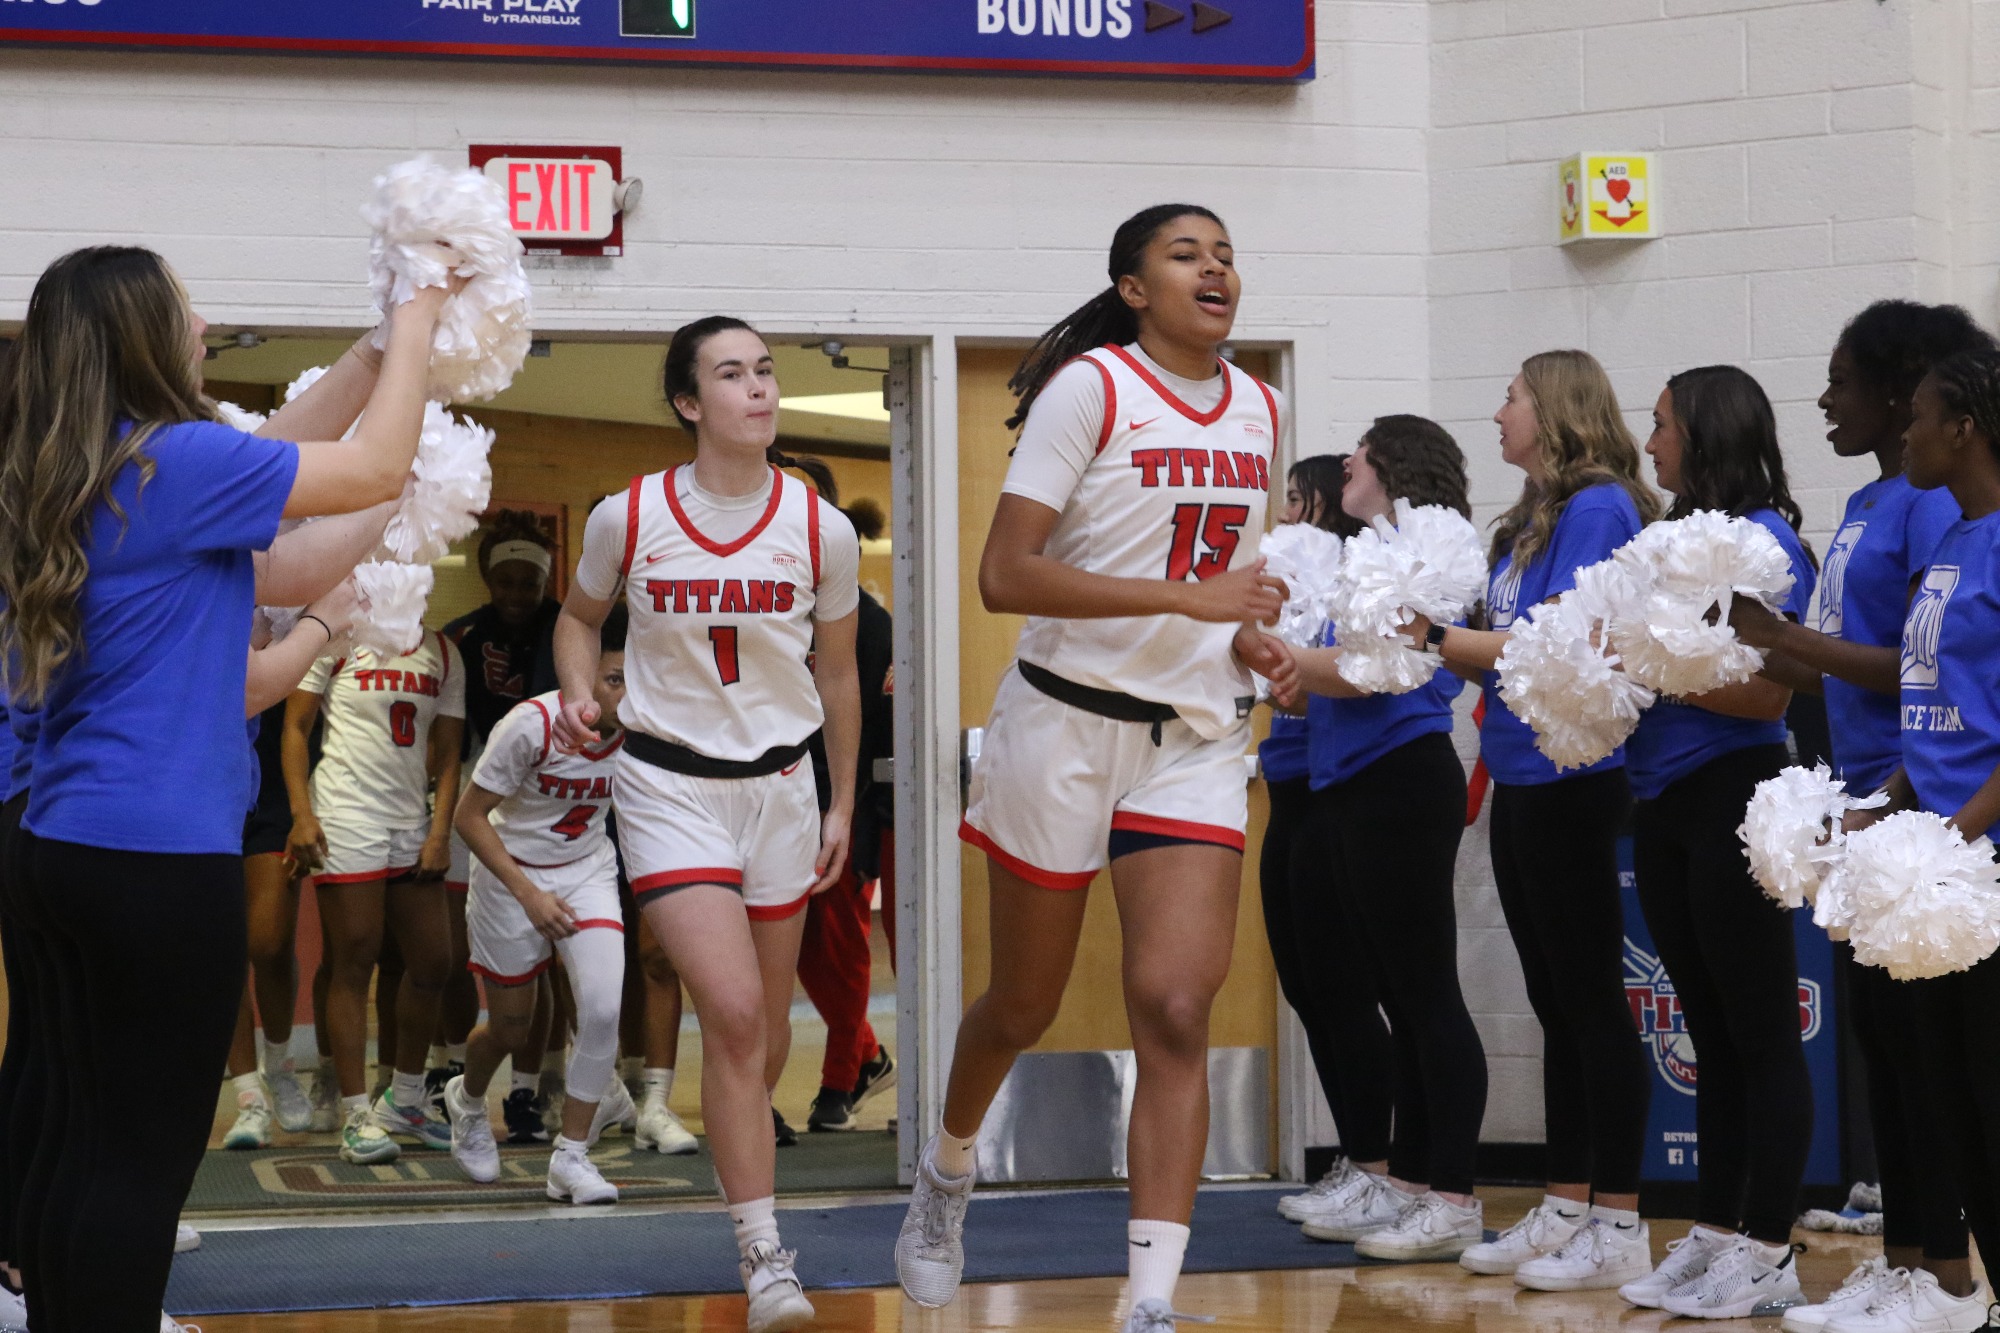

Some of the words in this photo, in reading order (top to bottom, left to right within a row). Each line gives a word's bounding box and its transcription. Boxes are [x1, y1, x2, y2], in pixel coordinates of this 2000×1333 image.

[483, 14, 499, 24] by
[501, 14, 581, 25] TRANSLUX
[504, 0, 581, 13] PLAY
[977, 0, 1132, 38] BONUS
[1609, 166, 1626, 175] AED
[508, 163, 596, 231] EXIT
[1131, 448, 1269, 492] TITANS
[1165, 502, 1250, 582] 15
[646, 578, 797, 613] TITANS
[708, 625, 741, 687] 1
[389, 700, 418, 748] 0
[1901, 705, 1927, 730] NCE
[1928, 705, 1965, 731] TEAM
[536, 772, 614, 800] TITA
[550, 804, 599, 842] 4
